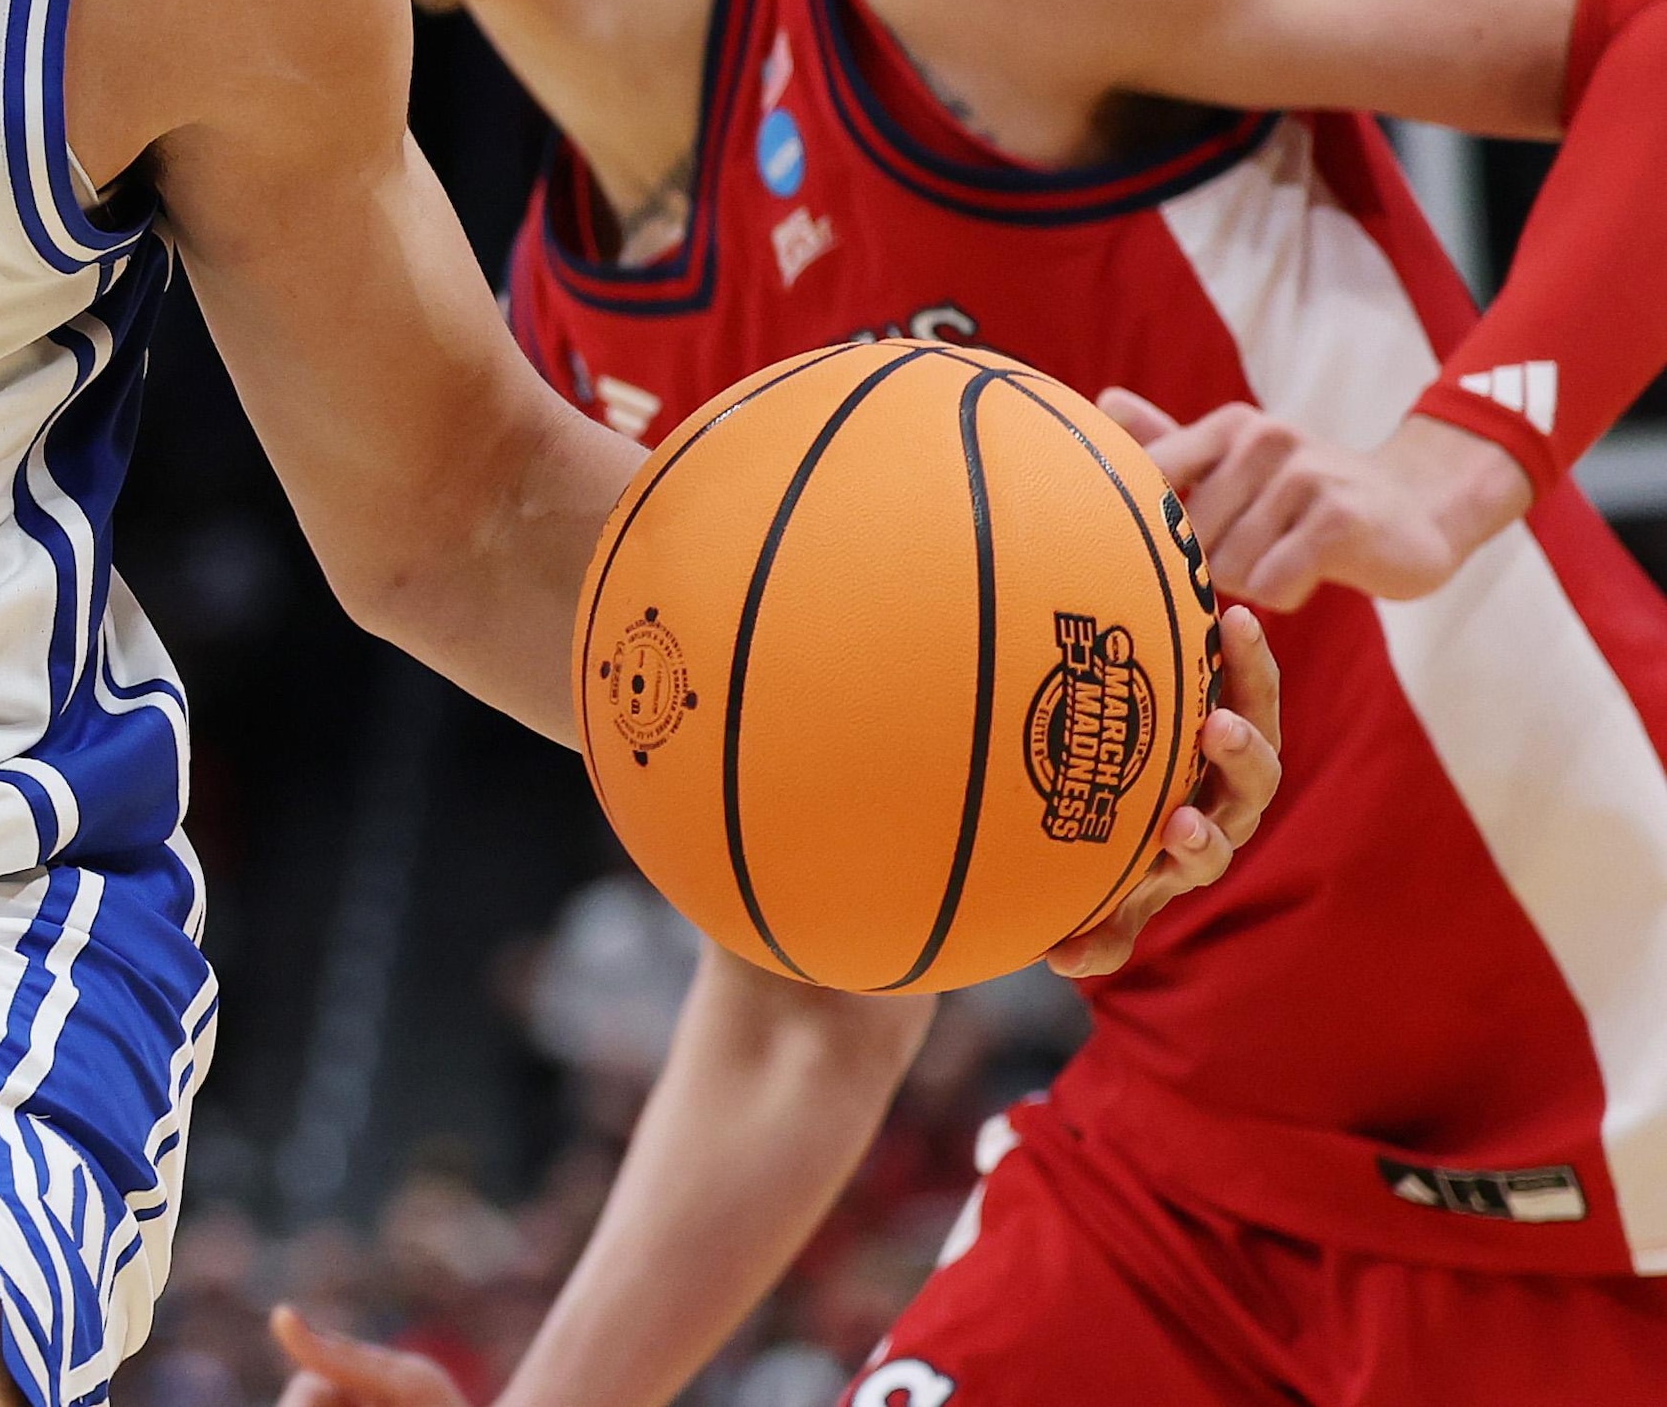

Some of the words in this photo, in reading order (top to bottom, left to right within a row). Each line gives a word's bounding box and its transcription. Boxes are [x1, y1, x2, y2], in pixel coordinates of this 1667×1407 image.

[1033, 708, 1049, 744] ELITE
[1095, 665, 1130, 787] MARCH
[1139, 694, 1151, 736] SWEET
[1052, 681, 1103, 839] MADNESS
